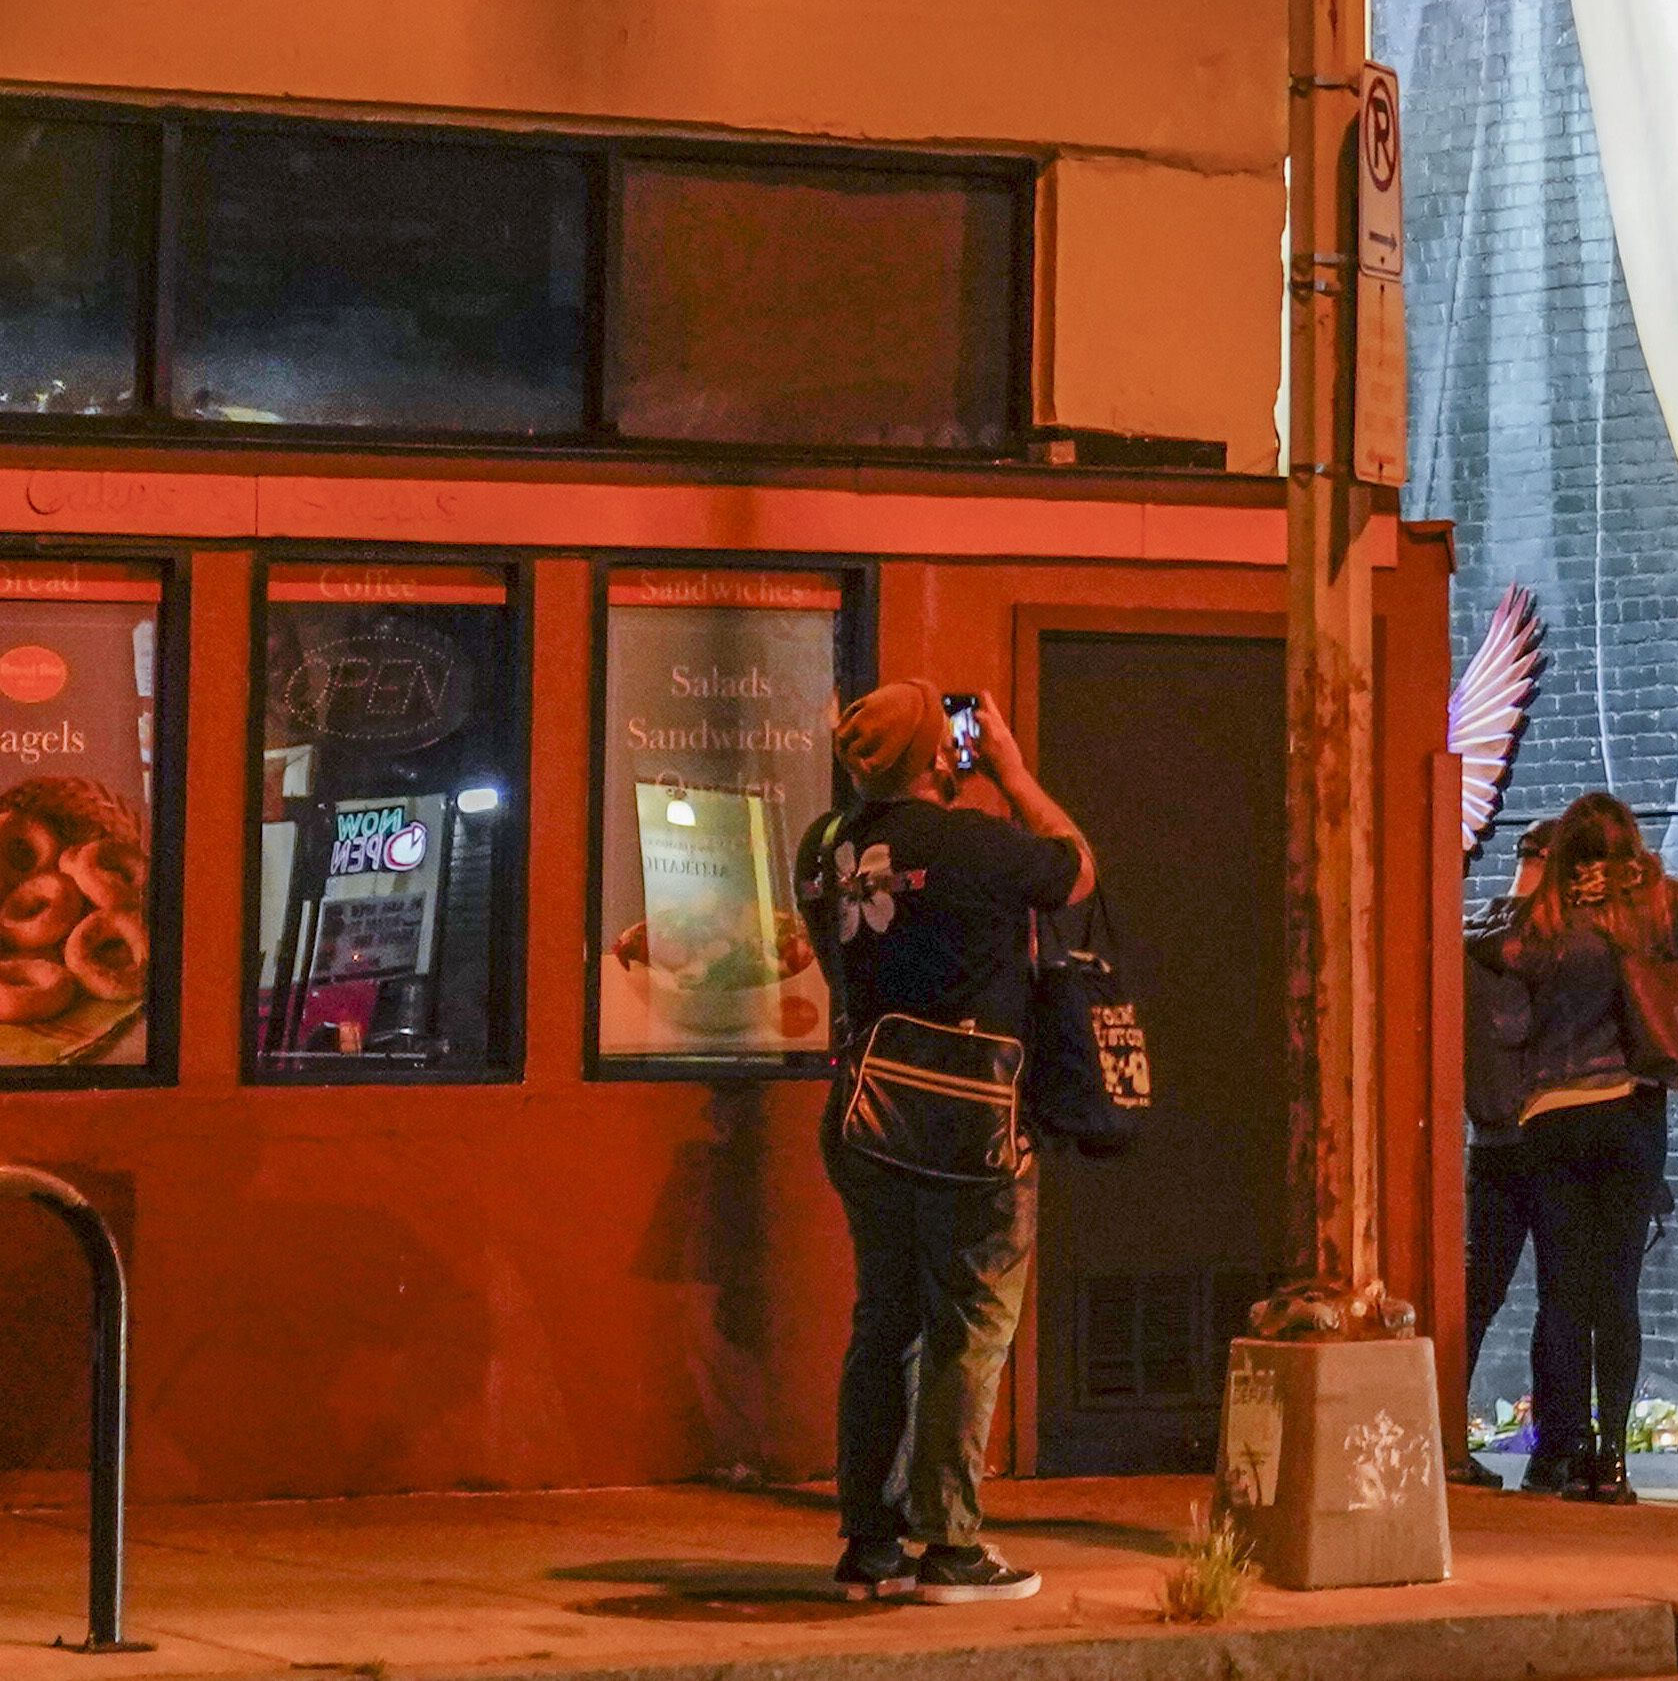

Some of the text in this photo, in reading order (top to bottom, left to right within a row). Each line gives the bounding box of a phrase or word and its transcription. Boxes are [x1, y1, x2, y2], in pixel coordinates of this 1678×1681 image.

[319, 567, 418, 598] Coffee
[640, 572, 805, 604] Sandwiches
[285, 656, 454, 715] OPEN
[671, 665, 773, 699] Salads
[0, 719, 85, 765] agels
[627, 716, 815, 752] Sandwiches
